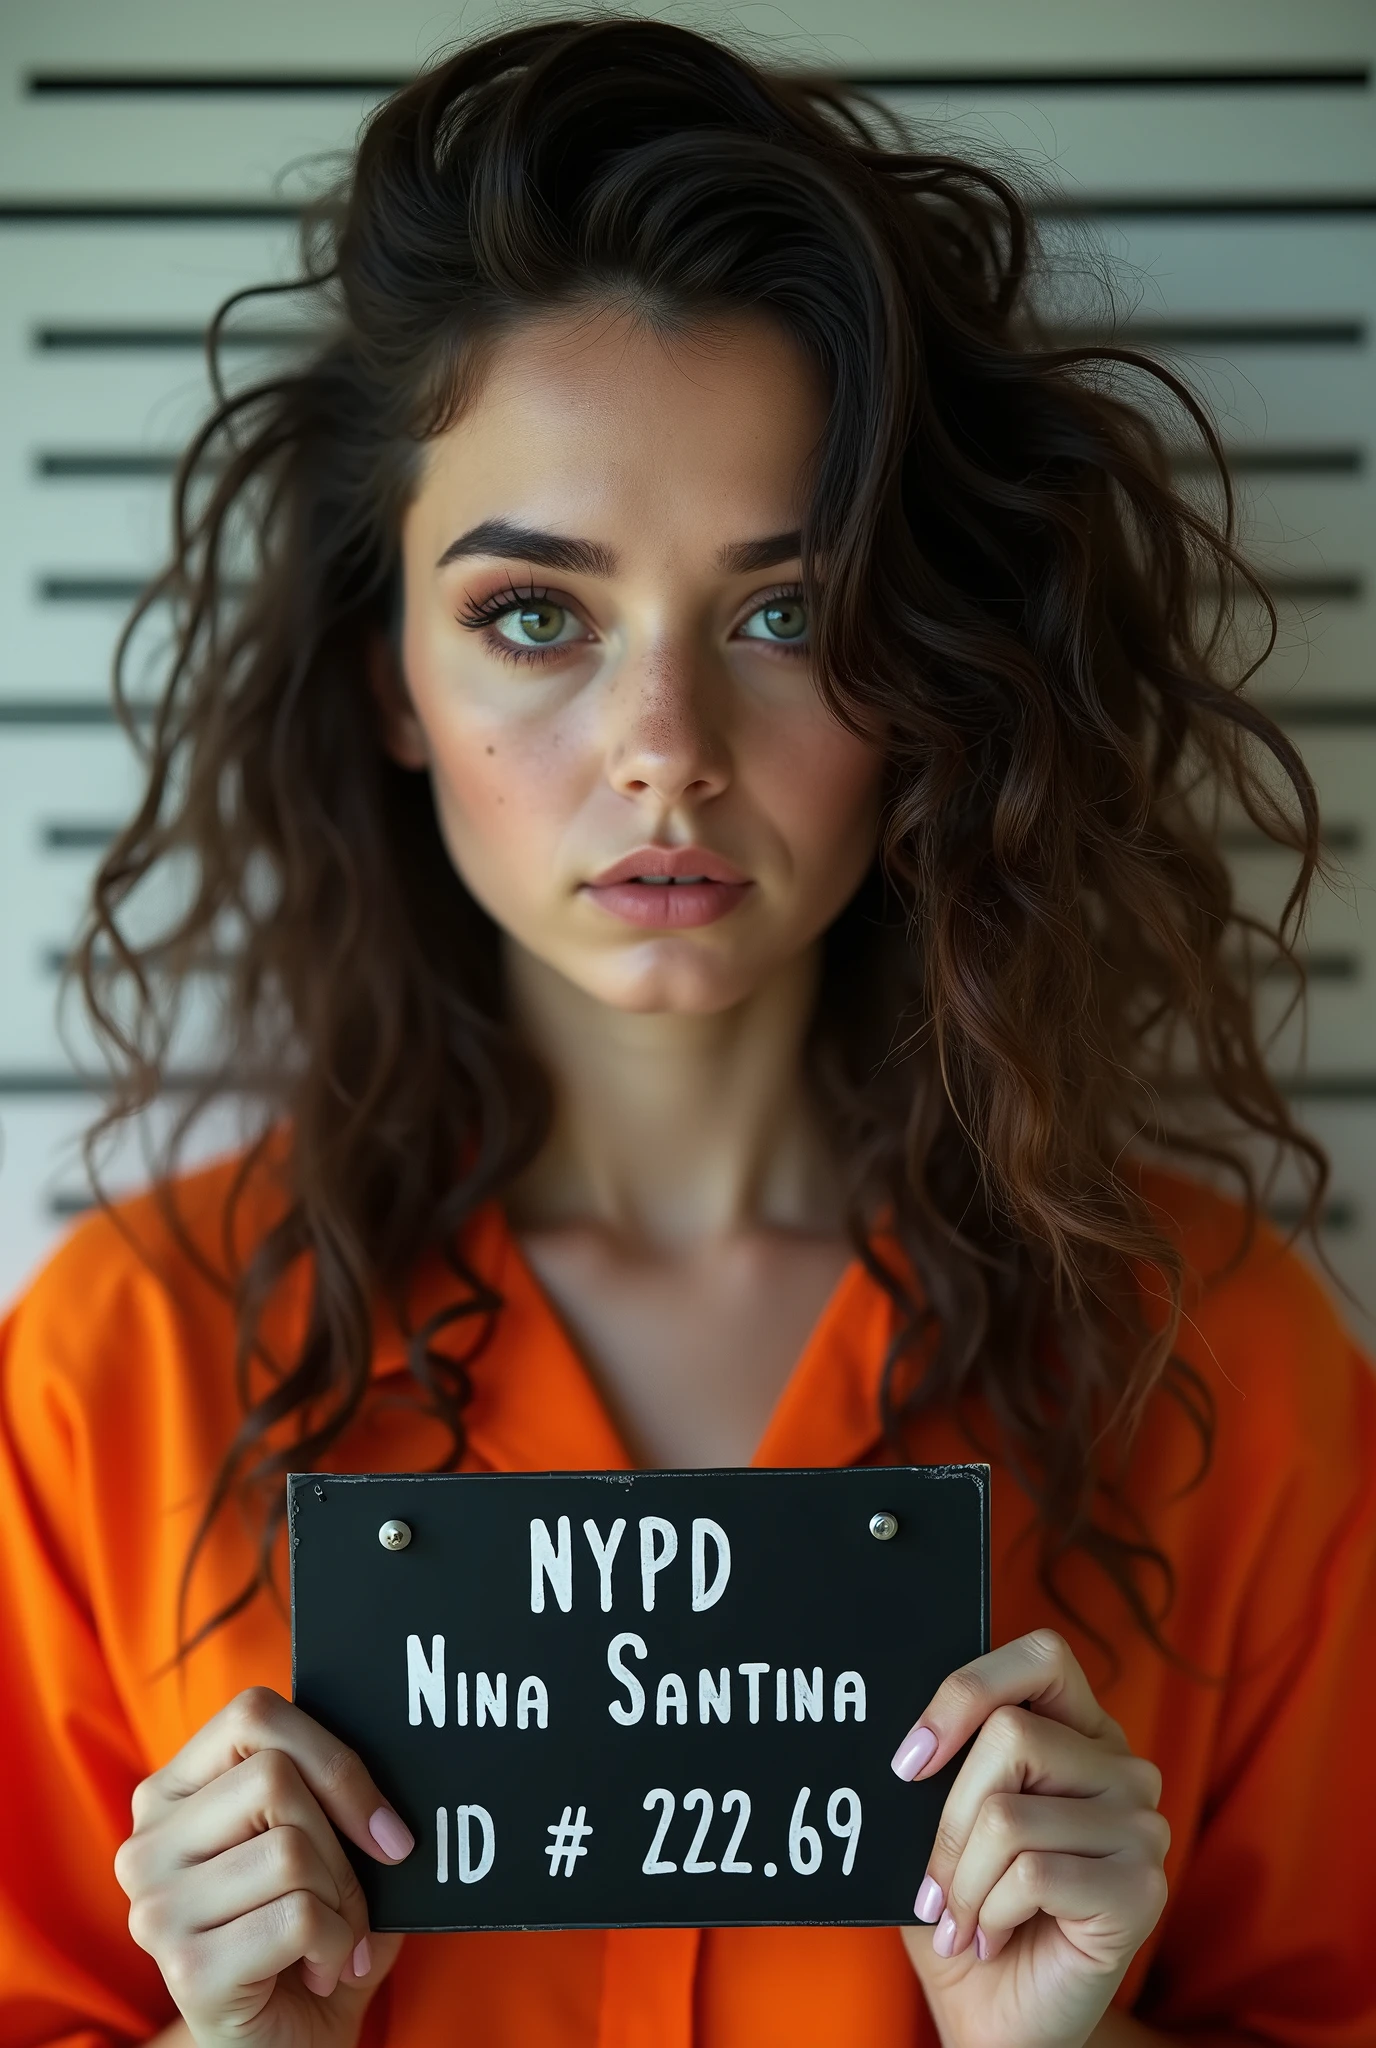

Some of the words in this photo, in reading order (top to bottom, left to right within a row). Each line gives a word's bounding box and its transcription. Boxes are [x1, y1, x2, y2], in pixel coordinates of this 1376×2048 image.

[528, 1514, 732, 1614] NYPD
[435, 1804, 497, 1885] ID
[543, 1804, 595, 1878] #
[640, 1785, 863, 1877] 222.69
